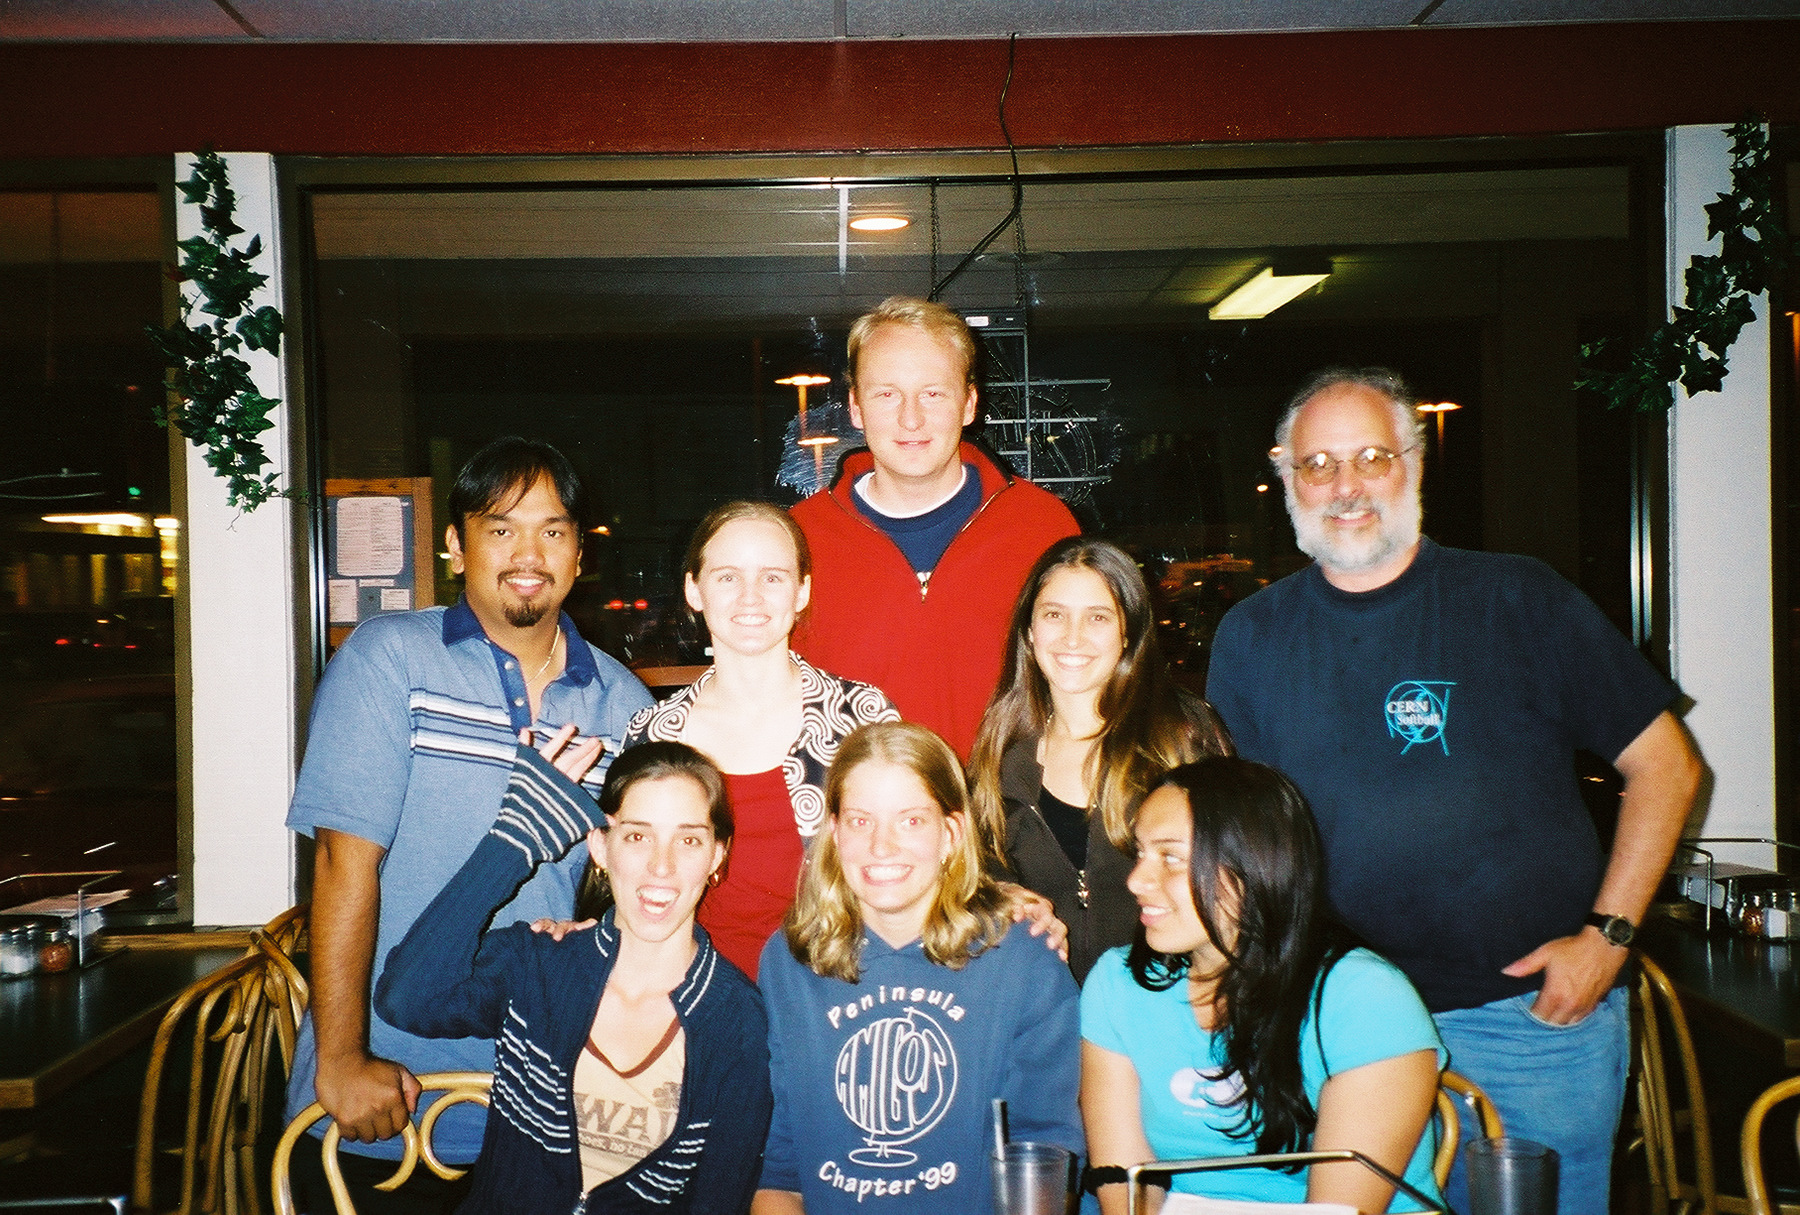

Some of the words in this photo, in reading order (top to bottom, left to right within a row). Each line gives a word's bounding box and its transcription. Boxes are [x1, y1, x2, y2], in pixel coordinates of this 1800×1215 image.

[1386, 700, 1429, 714] CERN
[827, 985, 965, 1029] Peninsula
[818, 1160, 916, 1203] Chapter
